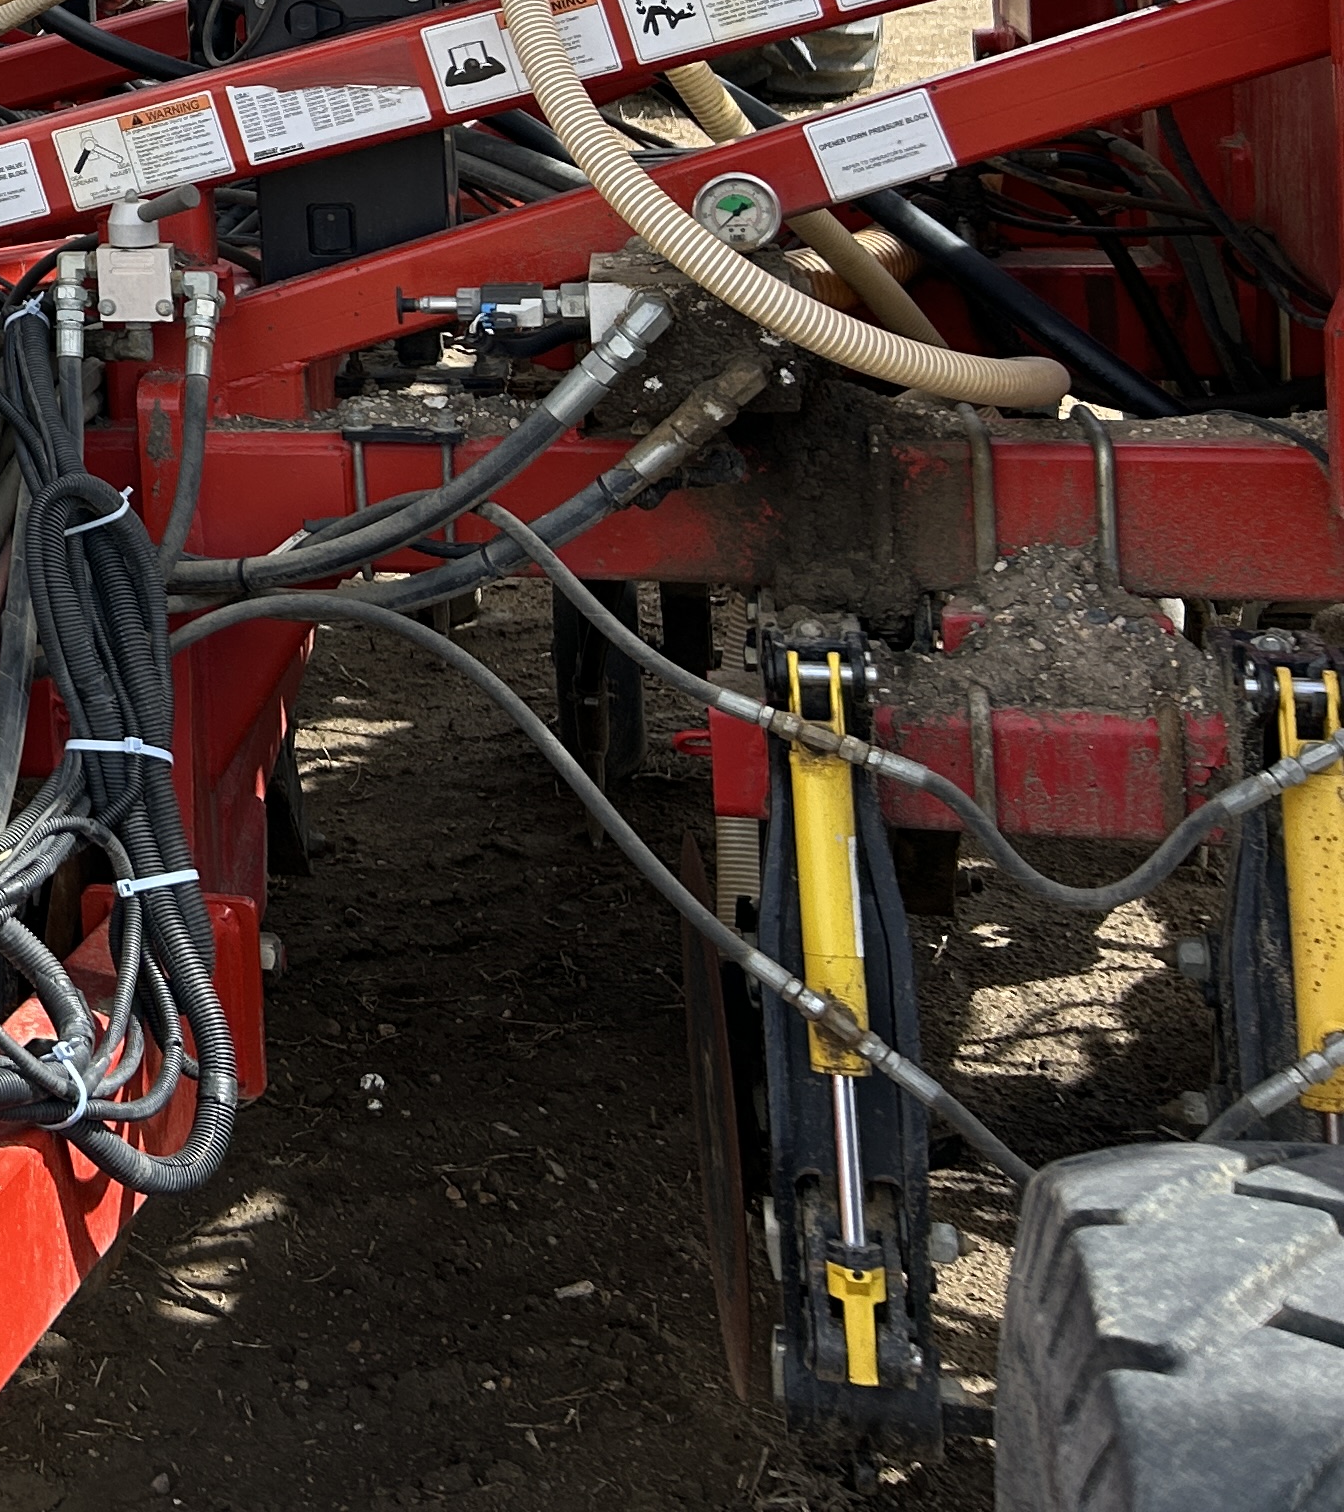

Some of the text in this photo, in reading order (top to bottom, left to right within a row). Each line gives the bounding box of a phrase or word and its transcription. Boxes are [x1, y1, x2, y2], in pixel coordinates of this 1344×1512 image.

[146, 98, 199, 122] WARNING
[818, 111, 929, 151] OPENER DOWN PRESSURE BLOCK
[4, 161, 23, 171] VALVE
[8, 168, 28, 179] BLOCK
